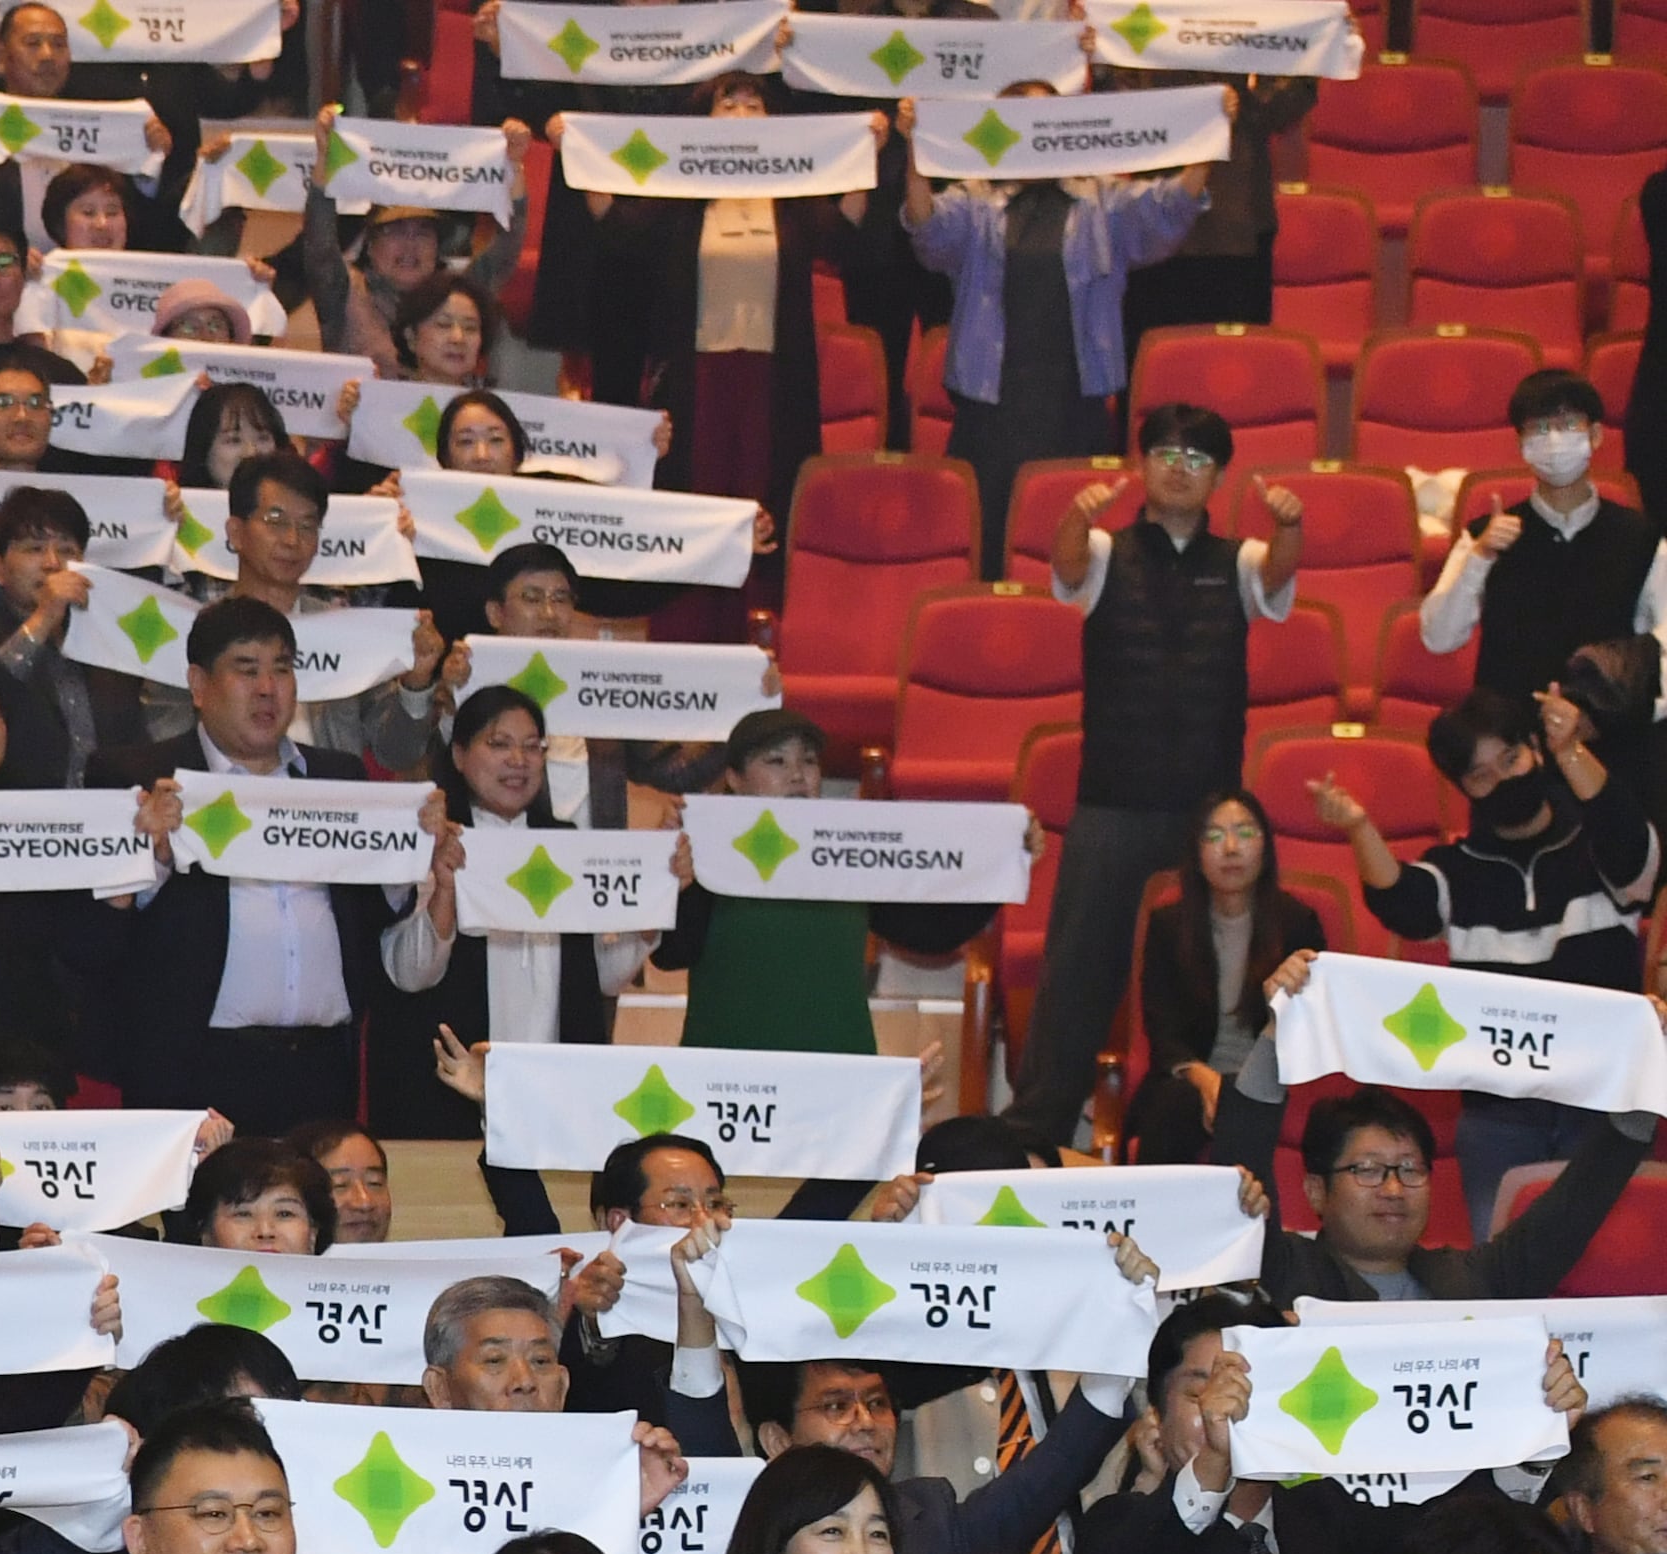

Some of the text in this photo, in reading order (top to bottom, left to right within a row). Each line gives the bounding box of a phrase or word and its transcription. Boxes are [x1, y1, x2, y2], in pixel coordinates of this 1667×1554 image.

[610, 41, 737, 64] GYEONGSAN
[1032, 126, 1167, 152] GYEONGSAN
[368, 158, 507, 185] GYEONGSAN
[679, 158, 813, 175] GYEONGSAN
[534, 509, 623, 529] MY UNIVERSE
[530, 522, 683, 556] GYEONGSAN
[269, 808, 358, 823] MY UNIVERSE
[264, 826, 417, 850] GYEONGSAN
[812, 847, 963, 869] GYEONGSAN
[583, 874, 641, 907] 경산
[1480, 1026, 1554, 1070] 경산
[704, 1102, 776, 1144] 경산
[25, 1161, 96, 1199] 경산
[306, 1302, 387, 1344] 경산
[910, 1284, 996, 1329] 경산
[1393, 1382, 1477, 1434] 경산
[449, 1480, 535, 1534] 경산
